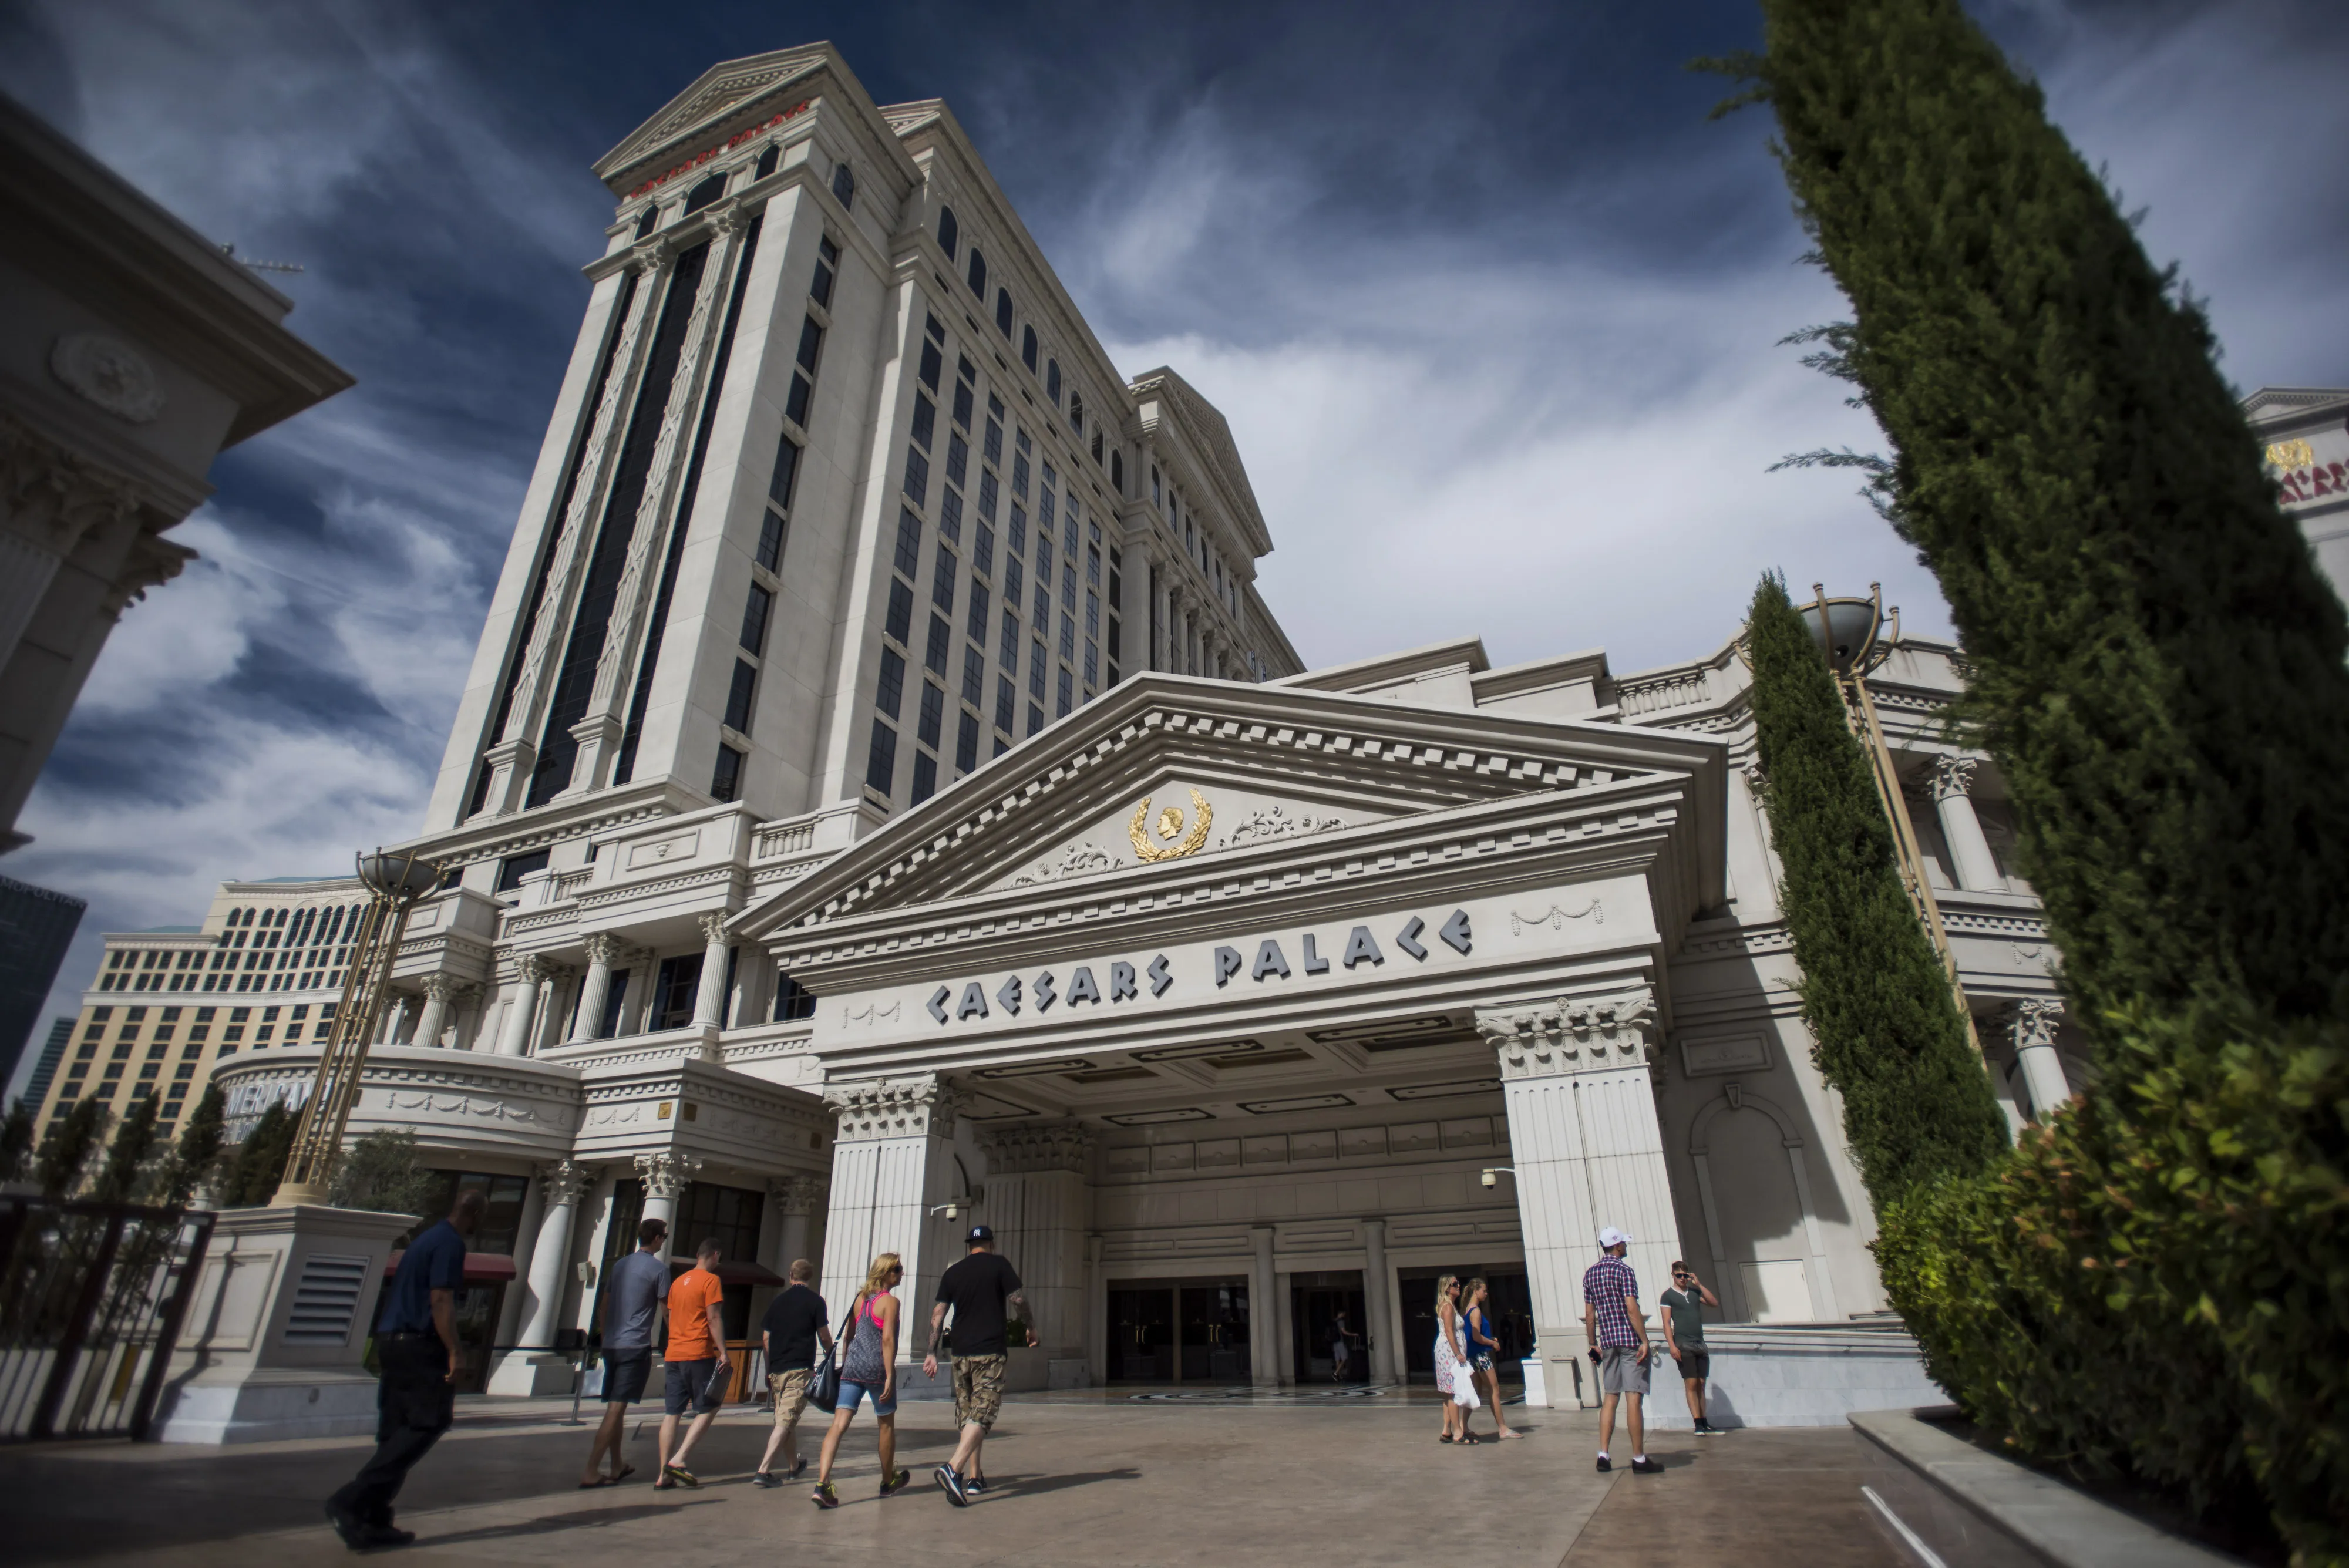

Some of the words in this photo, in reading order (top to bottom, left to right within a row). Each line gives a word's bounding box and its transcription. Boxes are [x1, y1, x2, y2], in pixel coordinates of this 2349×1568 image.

[728, 99, 811, 150] PALACE
[926, 953, 1174, 1026] CAESARS
[1214, 909, 1473, 989] PALACE
